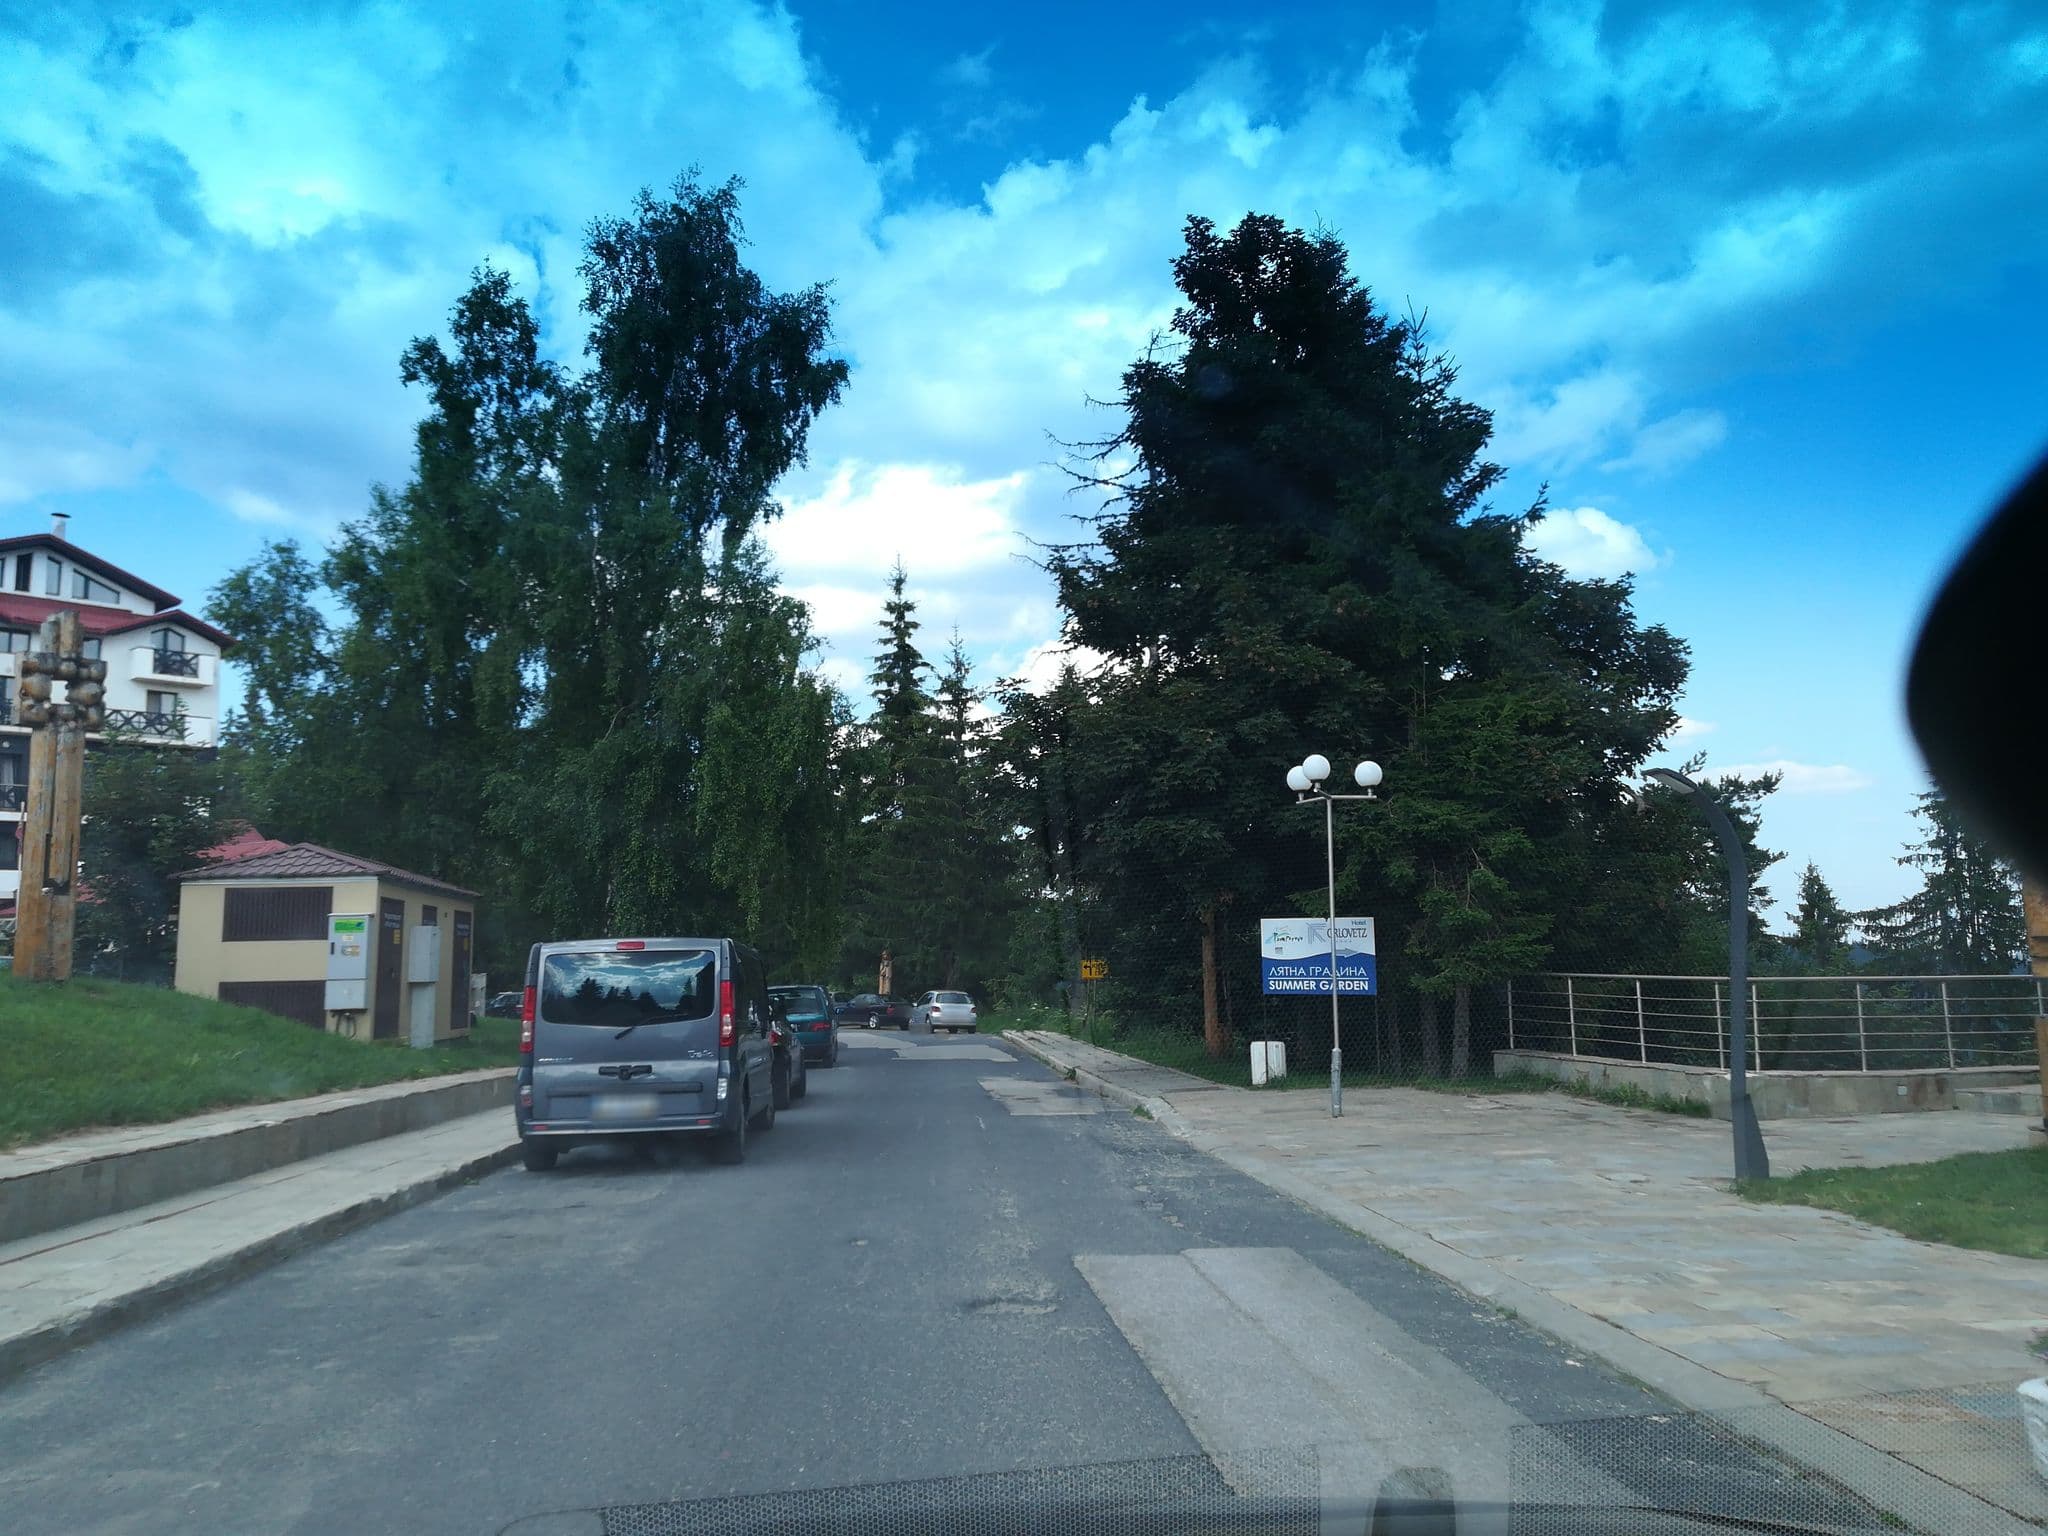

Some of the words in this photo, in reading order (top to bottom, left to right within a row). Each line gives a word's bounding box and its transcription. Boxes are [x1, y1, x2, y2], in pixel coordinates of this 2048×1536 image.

[1327, 928, 1368, 938] ORLOVETZ
[1269, 966, 1306, 977] ЛЯТНА
[1269, 980, 1316, 990] SUMMER
